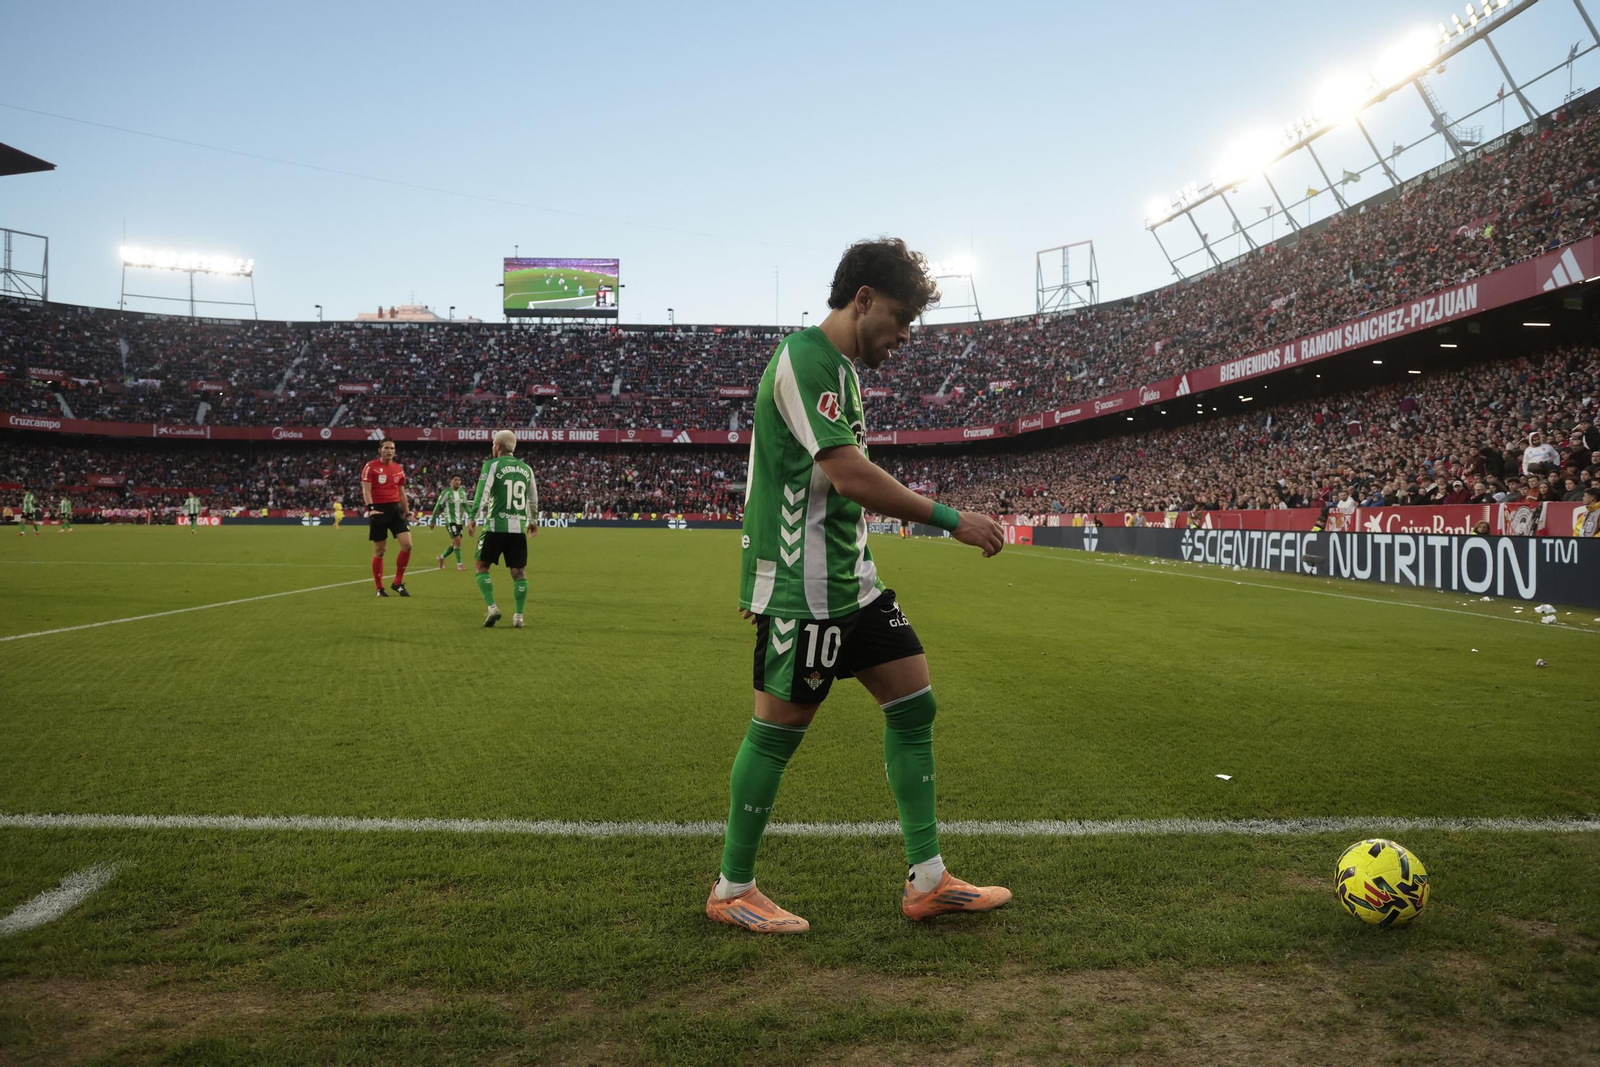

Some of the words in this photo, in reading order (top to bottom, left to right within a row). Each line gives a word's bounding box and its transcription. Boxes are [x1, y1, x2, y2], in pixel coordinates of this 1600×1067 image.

[1220, 350, 1281, 382] BIENVENIDOS
[1284, 344, 1297, 365] AL
[1301, 331, 1343, 360] RAMON
[1345, 284, 1478, 346] SANCHEZ-PIZJUAN
[9, 415, 60, 429] Cruzcampo
[169, 428, 206, 436] CaixaBank
[458, 430, 488, 440] DICEN
[515, 430, 550, 440] NUNCA
[552, 431, 564, 440] SE
[568, 431, 600, 440] RINDE
[963, 428, 995, 439] Cruzcampo
[504, 480, 526, 510] 19
[1329, 532, 1536, 600] NUTRITION
[804, 624, 842, 668] 10
